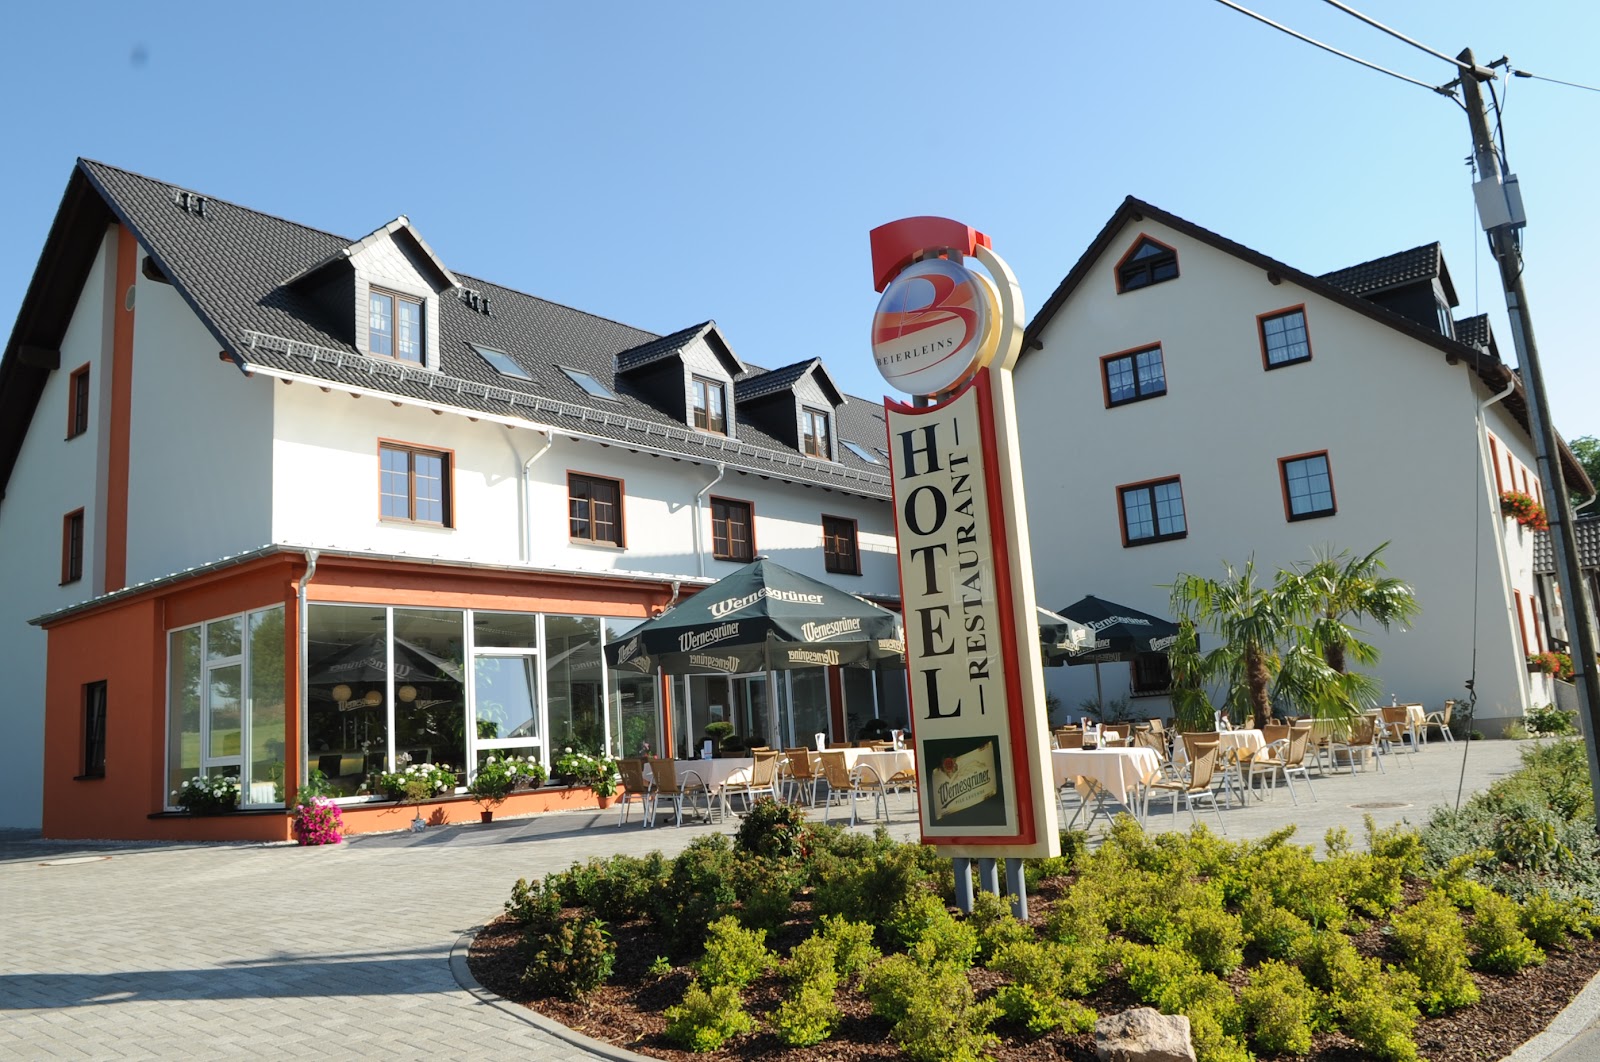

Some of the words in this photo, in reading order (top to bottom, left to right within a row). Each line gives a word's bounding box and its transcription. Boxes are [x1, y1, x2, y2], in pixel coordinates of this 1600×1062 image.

[876, 337, 954, 367] BEIERLEINS
[896, 422, 962, 720] HOTEL
[948, 453, 991, 682] RESTAURANT
[707, 586, 825, 619] Wernesgrüner
[678, 622, 740, 652] Wernesgrüner
[801, 617, 862, 642] Wernesgrüner
[938, 769, 991, 806] Wernesgrüner
